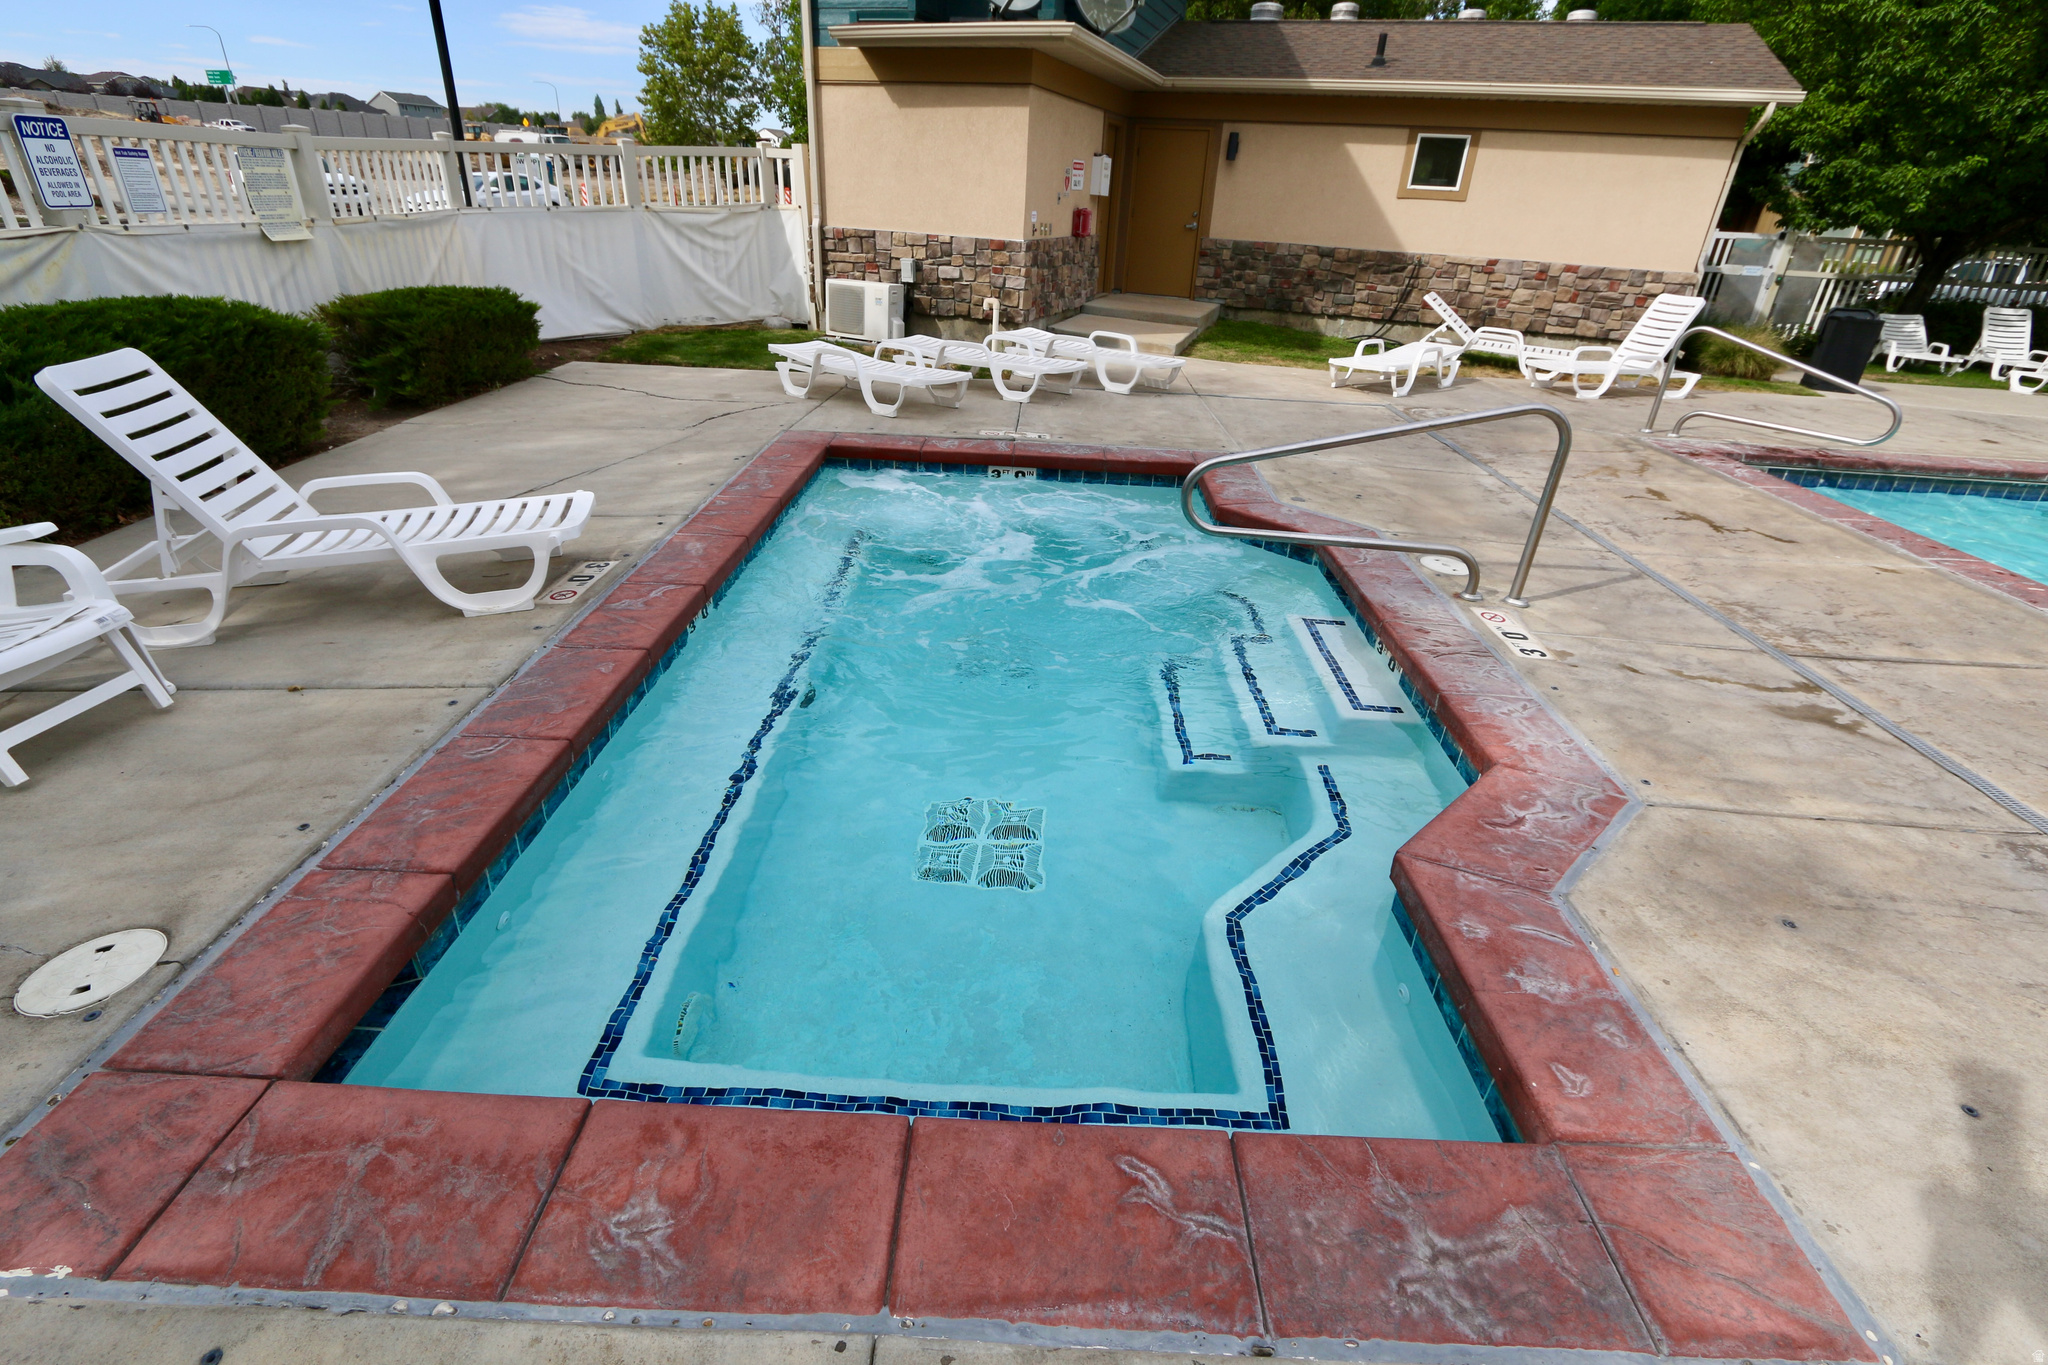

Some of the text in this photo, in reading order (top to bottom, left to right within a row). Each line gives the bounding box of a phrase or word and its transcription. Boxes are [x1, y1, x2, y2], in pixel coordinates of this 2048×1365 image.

[20, 121, 65, 137] NOTICE
[44, 144, 56, 152] NO
[35, 156, 74, 165] ALCOHOLIC
[39, 168, 78, 177] BEVERAGES
[1519, 648, 1547, 657] 3
